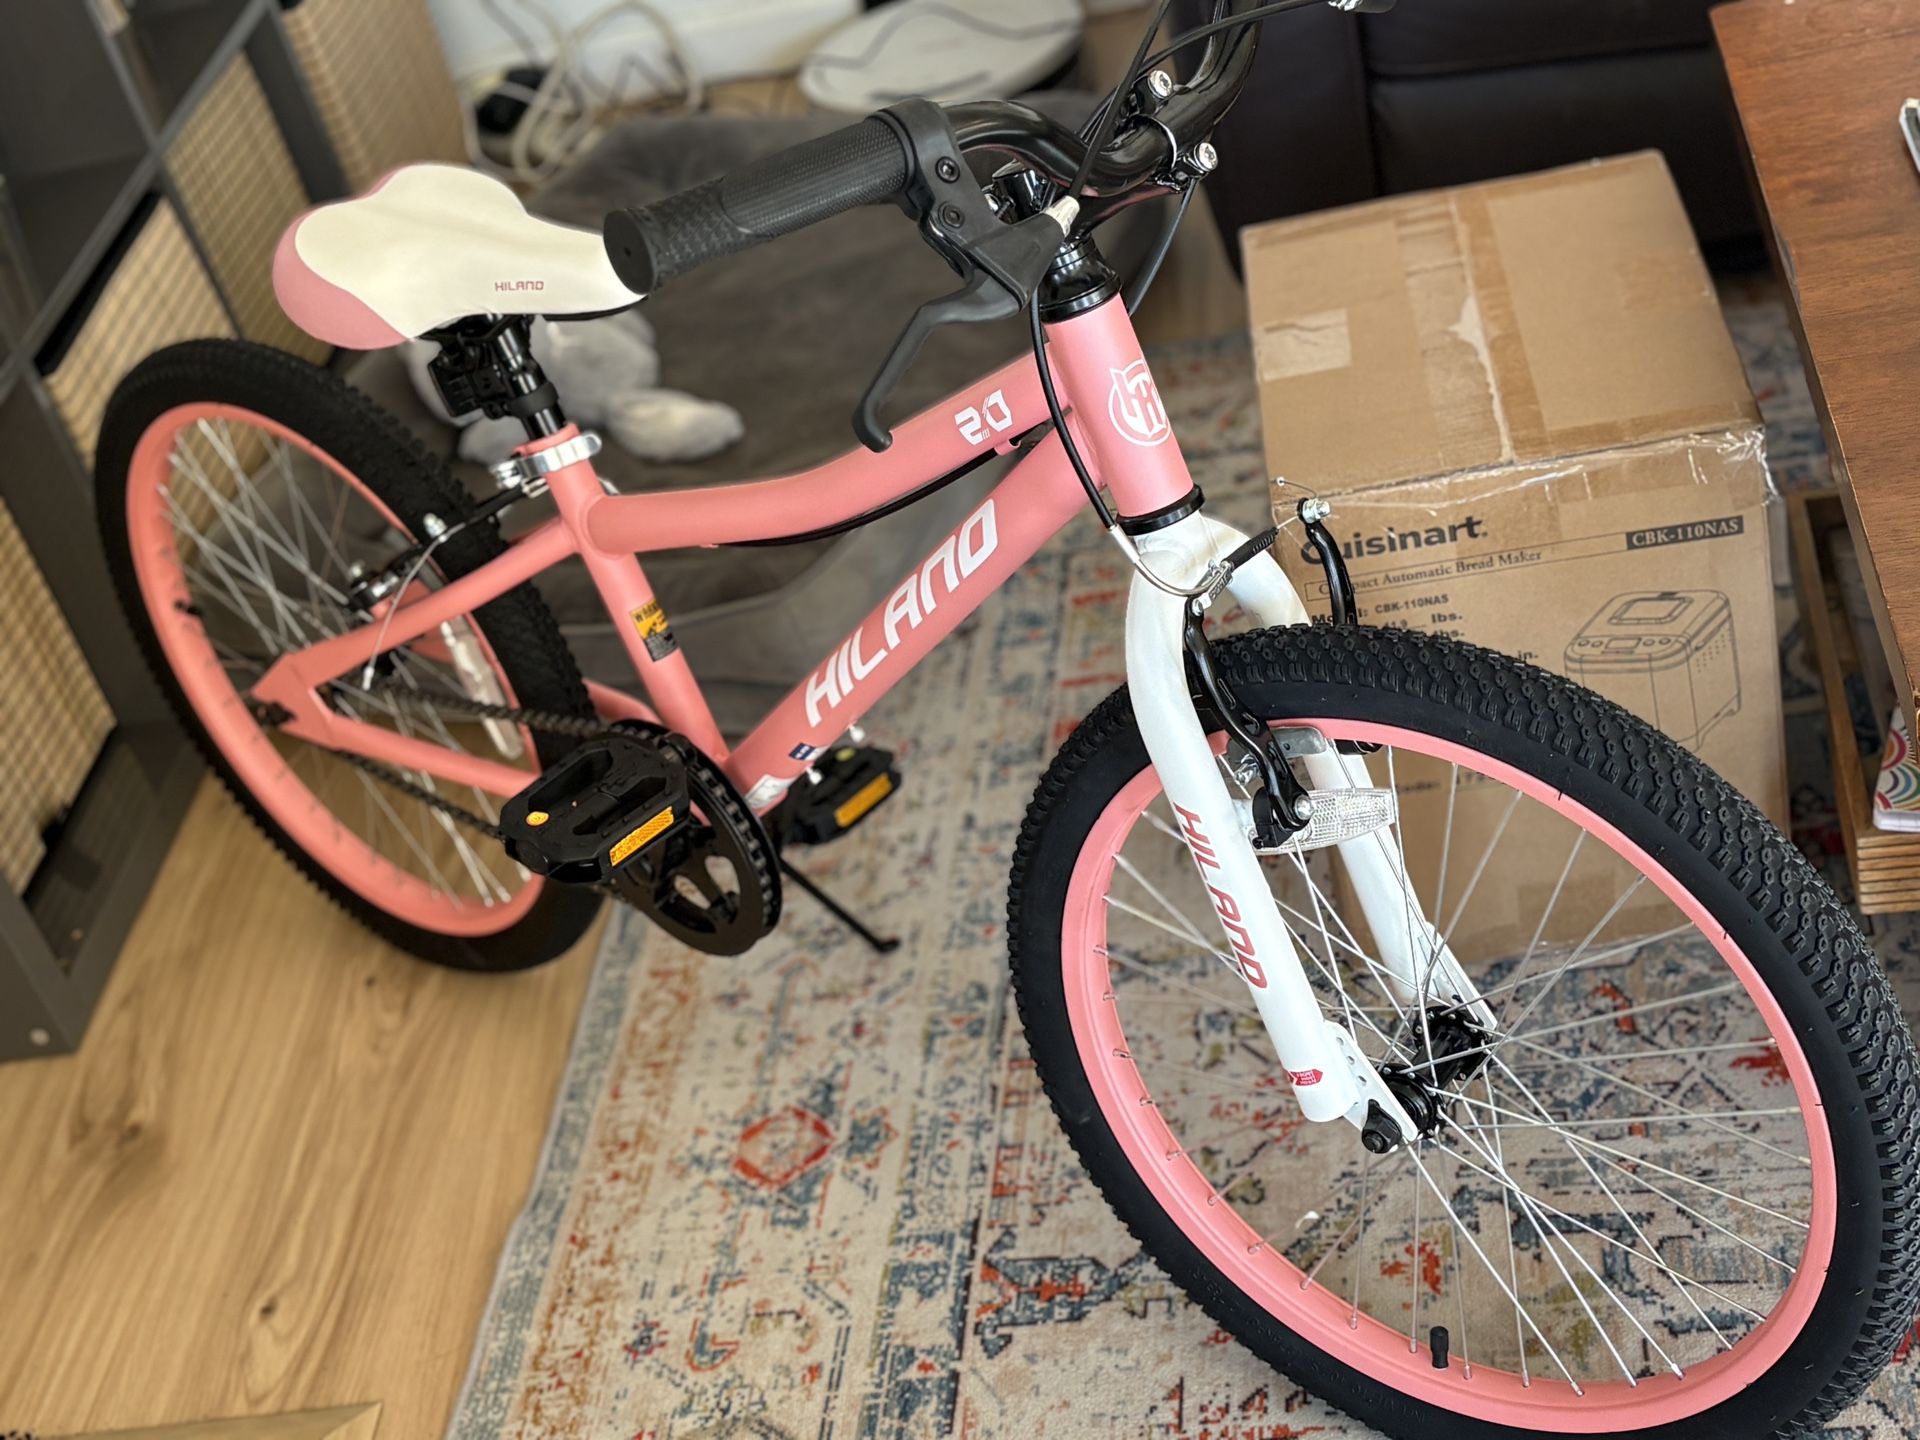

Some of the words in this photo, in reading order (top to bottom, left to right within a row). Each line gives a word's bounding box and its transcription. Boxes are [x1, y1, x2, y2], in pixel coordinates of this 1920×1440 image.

[494, 280, 545, 292] HILAND
[954, 389, 1013, 446] 20
[1632, 508, 1739, 547] CBK-110NAS
[1319, 577, 1379, 596] Cpact
[1383, 563, 1453, 585] Automatic
[1456, 556, 1494, 573] Bread
[1499, 550, 1542, 566] Maker
[804, 498, 999, 728] HILAND
[1374, 594, 1449, 615] CBK-110NAS
[1173, 801, 1268, 989] HILAND
